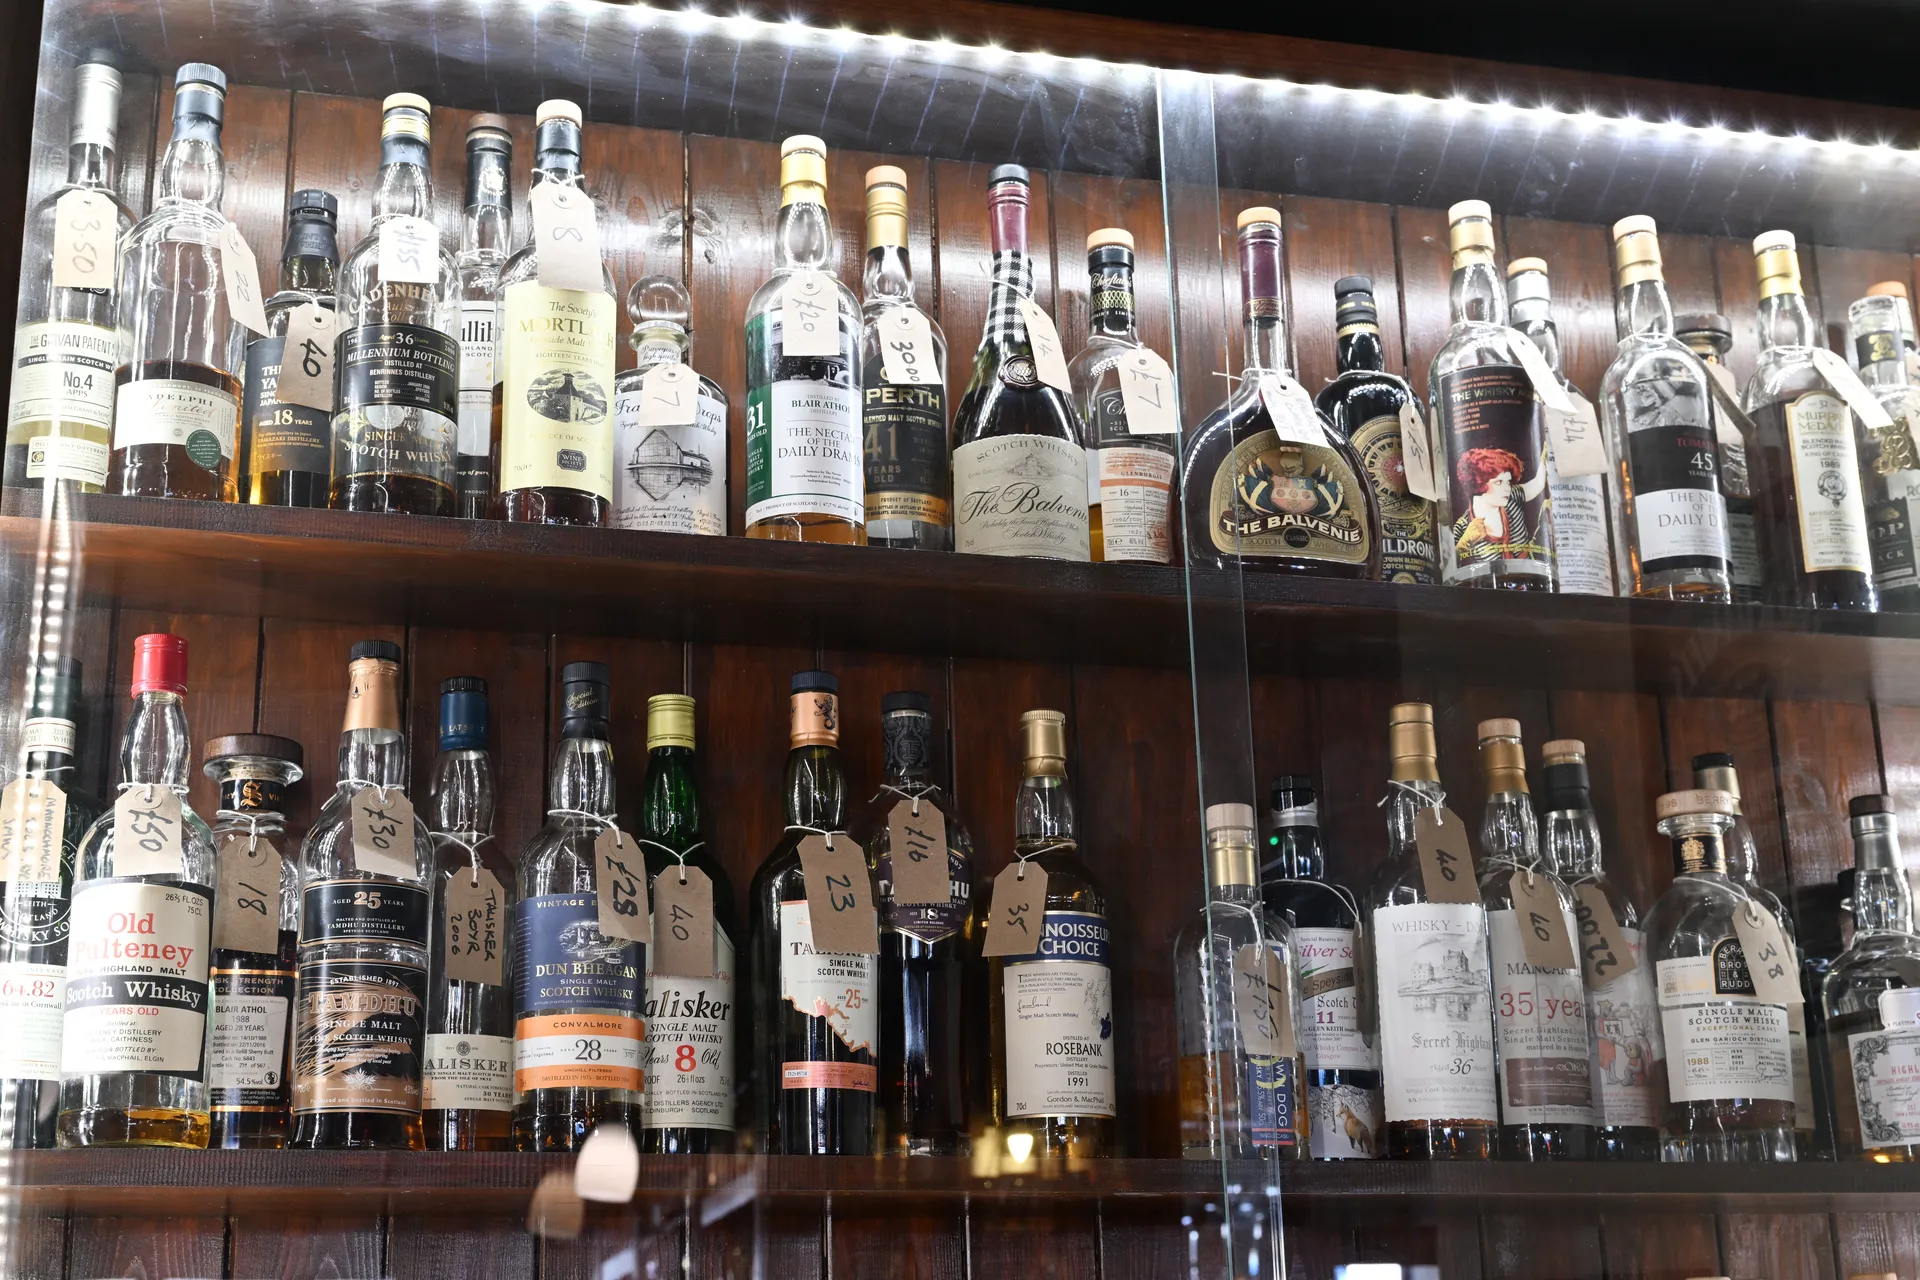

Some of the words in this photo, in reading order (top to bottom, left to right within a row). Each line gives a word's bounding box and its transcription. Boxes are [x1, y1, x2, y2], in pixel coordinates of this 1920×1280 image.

[549, 301, 566, 313] The
[791, 296, 827, 333] £20
[396, 332, 414, 346] 36
[77, 358, 103, 368] SCOTCH
[300, 337, 327, 378] 40
[346, 348, 410, 364] MILLENNIUM
[413, 350, 455, 374] BOTTLING
[384, 359, 414, 369] DISTILLED
[63, 371, 93, 390] No.4
[369, 367, 403, 376] BENRINNES
[404, 370, 436, 382] DISTILLERY
[865, 387, 941, 410] PERTH
[1451, 390, 1472, 403] THE
[1474, 386, 1516, 398] WHISKY
[791, 400, 822, 408] BLAIR
[274, 409, 293, 425] 18
[887, 413, 904, 422] MALT
[786, 427, 813, 437] THE
[806, 437, 821, 445] OF
[822, 438, 841, 449] THE
[863, 422, 899, 462] 41
[344, 441, 400, 460] SCOTCH
[406, 450, 451, 462] WHISKY
[777, 446, 819, 459] DAILY
[976, 439, 1029, 463] SCOTCH
[1033, 439, 1080, 466] WHISKY
[1690, 451, 1714, 471] 45
[1820, 460, 1841, 469] 1989
[867, 464, 902, 475] YEARS
[1688, 469, 1707, 477] YEARS
[873, 475, 895, 484] OLD
[1119, 487, 1129, 498] 16
[1550, 483, 1584, 493] HIGHLAND
[1667, 491, 1694, 503] THE
[958, 485, 1001, 525] The
[1692, 502, 1705, 512] OF
[1552, 511, 1585, 523] Vintage
[1658, 513, 1704, 528] DAILY
[1223, 518, 1262, 535] THE
[1267, 513, 1361, 543] BALVENIE
[128, 808, 175, 854] £50
[362, 805, 405, 851] £30
[1435, 848, 1457, 883] 40
[604, 854, 642, 917] £28
[237, 881, 268, 916] 18
[825, 873, 857, 913] 23
[353, 890, 382, 910] 25
[383, 899, 405, 907] YEARS
[536, 899, 585, 909] VINTAGE
[918, 907, 940, 921] 18
[107, 912, 156, 935] Old
[326, 921, 360, 930] TAMDHU
[360, 921, 407, 932] DISTILLERY
[668, 902, 694, 942] 40
[1391, 919, 1451, 934] WHISKY
[1529, 910, 1550, 943] 40
[1039, 936, 1101, 957] CHOICE
[1299, 936, 1318, 944] Special
[75, 937, 195, 968] Pulteney
[100, 965, 154, 973] HIGHLAND
[159, 966, 187, 977] MALT
[535, 962, 568, 977] DUN
[571, 961, 638, 980] BHEAGAN
[829, 959, 854, 968] SINGLE
[854, 960, 870, 970] MALT
[817, 968, 845, 977] SCOTCH
[846, 969, 870, 980] WHISKY
[329, 974, 384, 986] ESTABLISHED
[385, 978, 400, 988] 1897
[596, 978, 618, 986] MALT
[66, 981, 114, 1005] Scotch
[124, 980, 202, 1009] Whisky
[539, 986, 590, 998] SCOTCH
[593, 986, 634, 1000] WHISKY
[845, 988, 861, 1010] 25
[30, 1000, 63, 1010] Cornwall
[308, 990, 418, 1017] TAMDHU
[1317, 995, 1350, 1008] Scotch
[1499, 991, 1534, 1018] 35
[100, 1006, 134, 1016] YEARS
[137, 1006, 160, 1016] OLD
[215, 1005, 239, 1014] BLAIR
[240, 1005, 268, 1014] ATHOL
[1697, 1008, 1744, 1017] SINGLE
[1747, 1008, 1774, 1018] MALT
[231, 1015, 250, 1023] 1988
[1316, 1010, 1336, 1024] 11
[1688, 1016, 1740, 1026] SCOTCH
[1743, 1016, 1781, 1026] WHISKY
[215, 1024, 234, 1032] AGED
[244, 1024, 265, 1032] YEARS
[322, 1019, 367, 1030] SINGLE
[370, 1020, 403, 1031] MALT
[552, 1021, 624, 1030] CONVALMORE
[649, 1022, 689, 1033] SINGLE
[692, 1023, 719, 1033] MALT
[1503, 1027, 1534, 1035] Secret
[1696, 1024, 1755, 1032] EXCEPTIONAL
[1756, 1025, 1778, 1033] CASKS
[119, 1028, 163, 1037] DISTILLERY
[688, 1033, 724, 1045] WHISKY
[332, 1033, 375, 1042] SCOTCH
[377, 1034, 413, 1046] WHISKY
[1411, 1032, 1452, 1052] Secret
[1504, 1035, 1533, 1044] Single
[1557, 1035, 1581, 1045] Scotch
[1749, 1036, 1782, 1044] DISTILLERY
[574, 1038, 603, 1062] 28
[1045, 1042, 1103, 1057] ROSEBANK
[144, 1054, 165, 1063] ELGIN
[674, 1044, 697, 1073] 8
[701, 1048, 720, 1070] Old
[1686, 1057, 1710, 1067] 1988
[1449, 1057, 1474, 1075] 36
[541, 1074, 572, 1082] DISTILLED
[1067, 1077, 1089, 1087] 1991
[691, 1100, 715, 1108] AGENCY
[1046, 1095, 1073, 1103] Gordon
[691, 1107, 720, 1115] SCOTLAND
[1276, 1092, 1288, 1128] DOG
